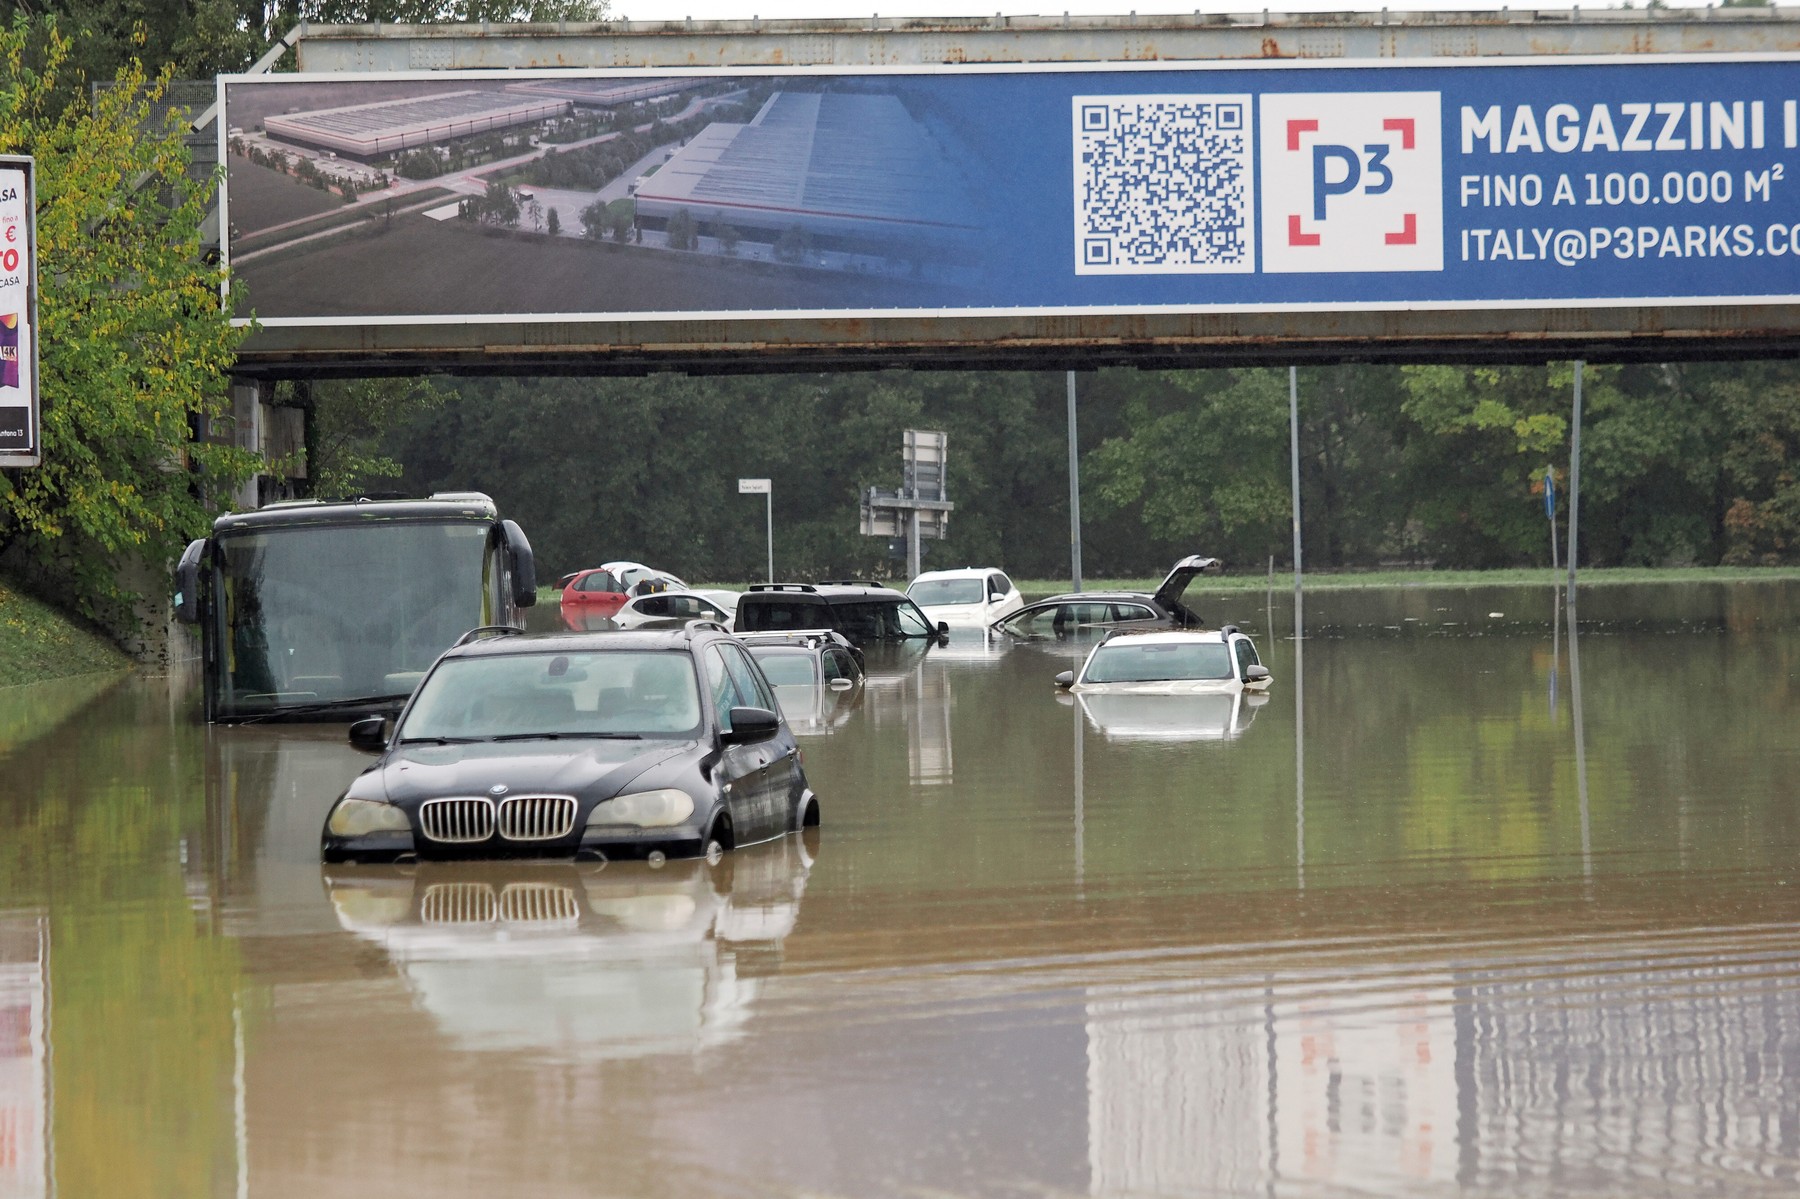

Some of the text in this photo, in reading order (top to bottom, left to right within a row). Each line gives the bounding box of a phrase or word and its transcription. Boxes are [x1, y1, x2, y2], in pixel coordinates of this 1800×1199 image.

[1461, 101, 1764, 154] MAGAZZINI
[0, 188, 17, 203] SA
[1461, 174, 1542, 208] FINO
[1552, 174, 1576, 206] A
[1585, 171, 1732, 205] 100.000
[5, 225, 17, 243] €
[0, 248, 19, 272] O
